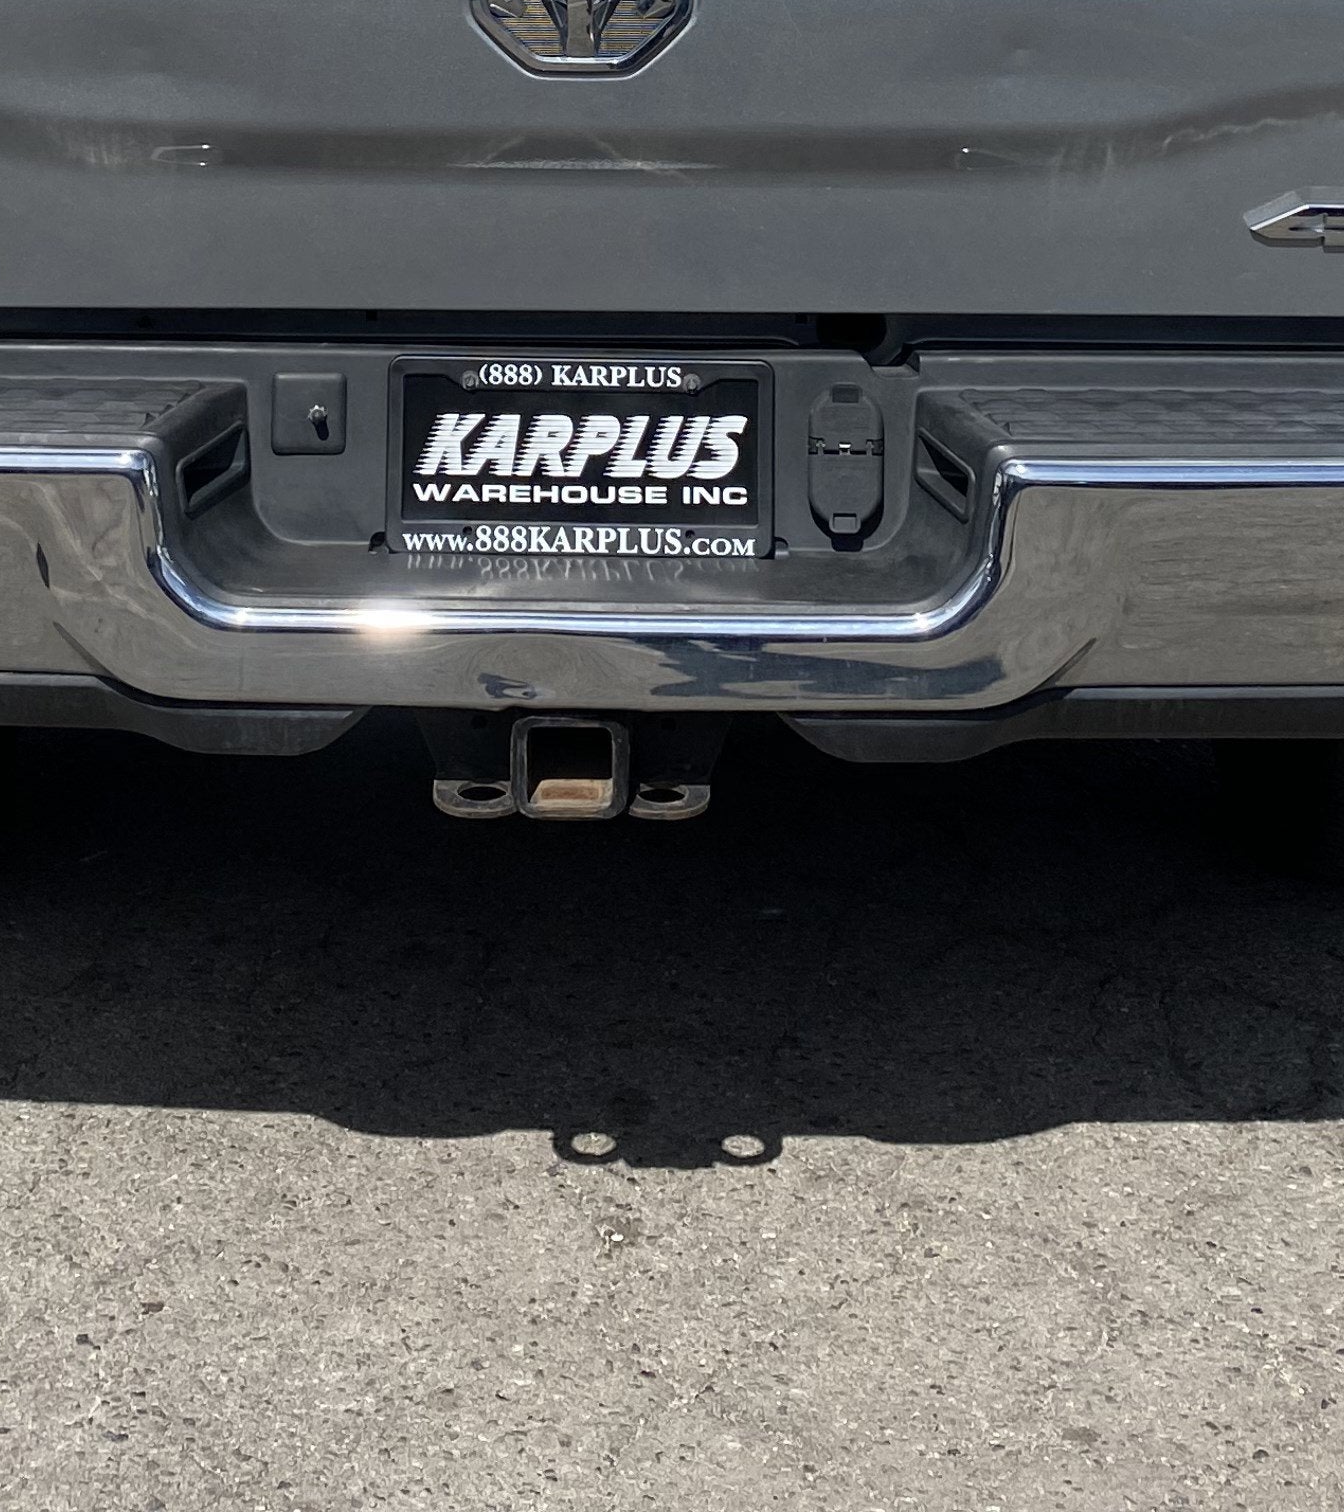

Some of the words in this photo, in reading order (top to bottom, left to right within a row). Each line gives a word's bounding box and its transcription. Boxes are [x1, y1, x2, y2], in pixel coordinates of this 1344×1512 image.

[478, 364, 543, 386] (888)
[552, 365, 682, 388] KARPLUS
[412, 413, 748, 480] KARPLUS
[413, 484, 668, 505] WAREHOUSE
[683, 485, 748, 506] INC
